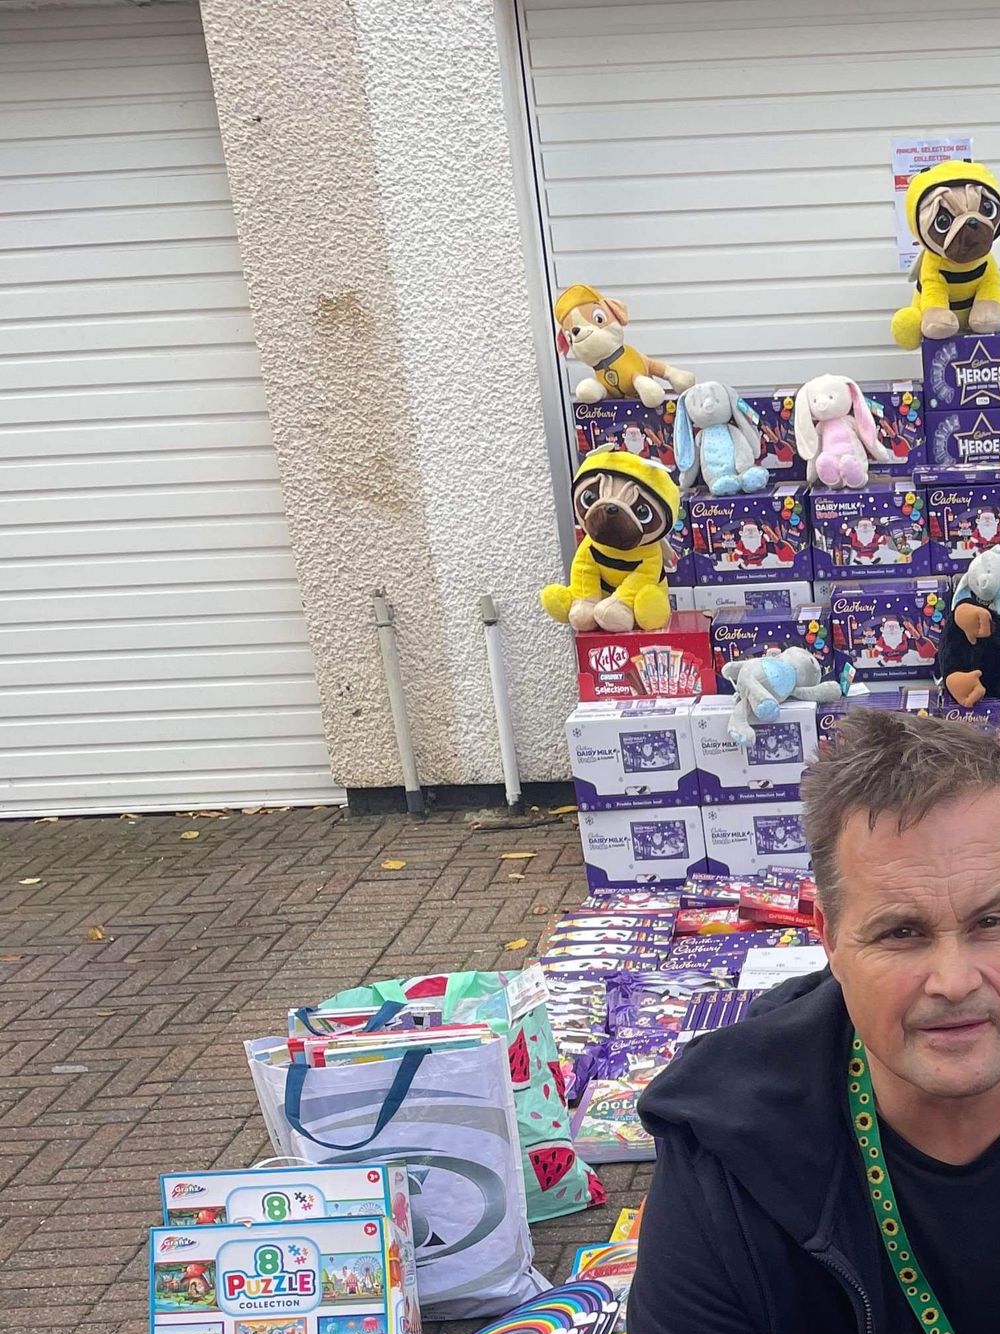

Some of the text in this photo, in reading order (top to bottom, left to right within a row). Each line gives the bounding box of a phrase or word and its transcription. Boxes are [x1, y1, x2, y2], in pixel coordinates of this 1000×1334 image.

[576, 404, 616, 420] Cadbury
[930, 491, 972, 506] Cadbury
[691, 503, 734, 518] Cadbury
[816, 502, 857, 511] DAIRY MILK
[834, 598, 876, 614] Cadbury
[715, 626, 758, 642] Cadbury
[591, 646, 627, 671] KitKat
[595, 685, 629, 695] Selection
[673, 945, 721, 955] Cadbury
[660, 960, 709, 971] Cadbury
[262, 1192, 290, 1221] 8
[256, 1245, 283, 1275] 8
[225, 1270, 316, 1299] PUZZLE
[239, 1300, 300, 1310] COLLECTION
